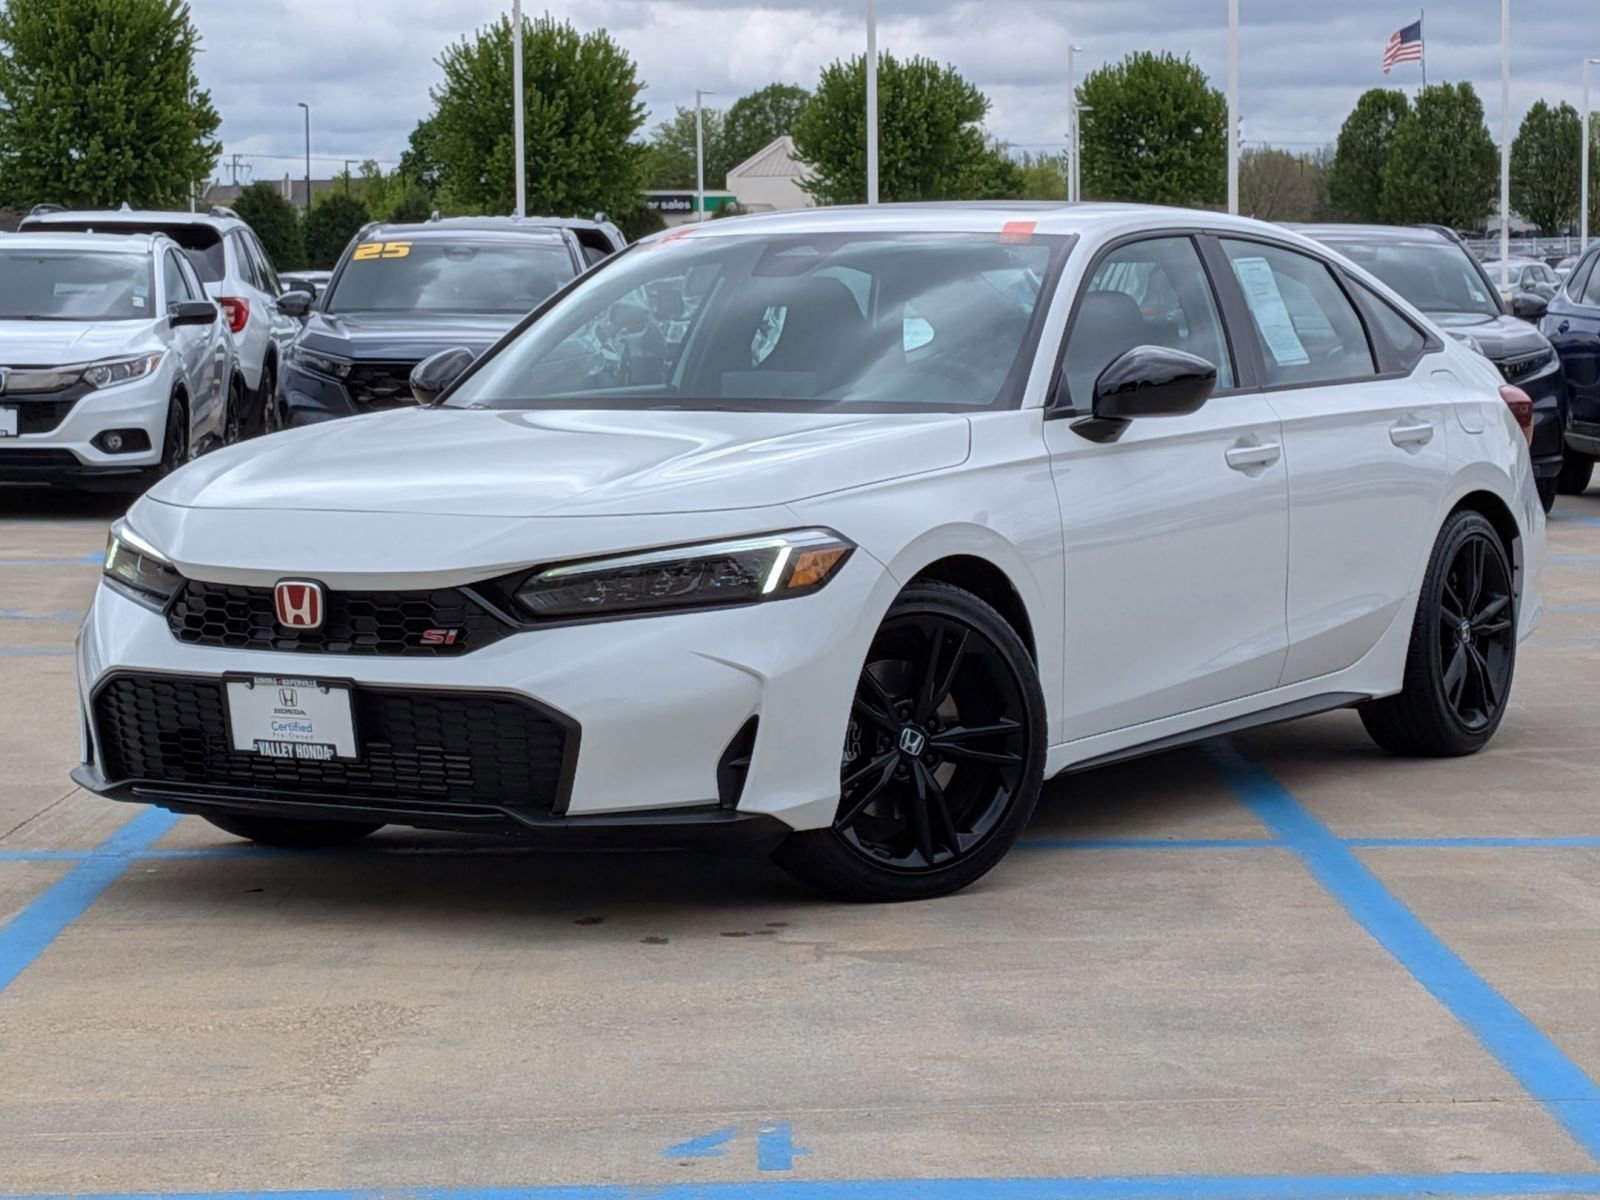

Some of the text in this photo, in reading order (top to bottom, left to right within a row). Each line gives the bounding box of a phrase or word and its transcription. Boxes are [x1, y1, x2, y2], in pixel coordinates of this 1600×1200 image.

[661, 198, 691, 210] sales
[353, 242, 412, 260] 25
[273, 708, 307, 716] HONDA
[271, 720, 313, 733] Certified
[257, 740, 332, 760] VALLEY HONDA
